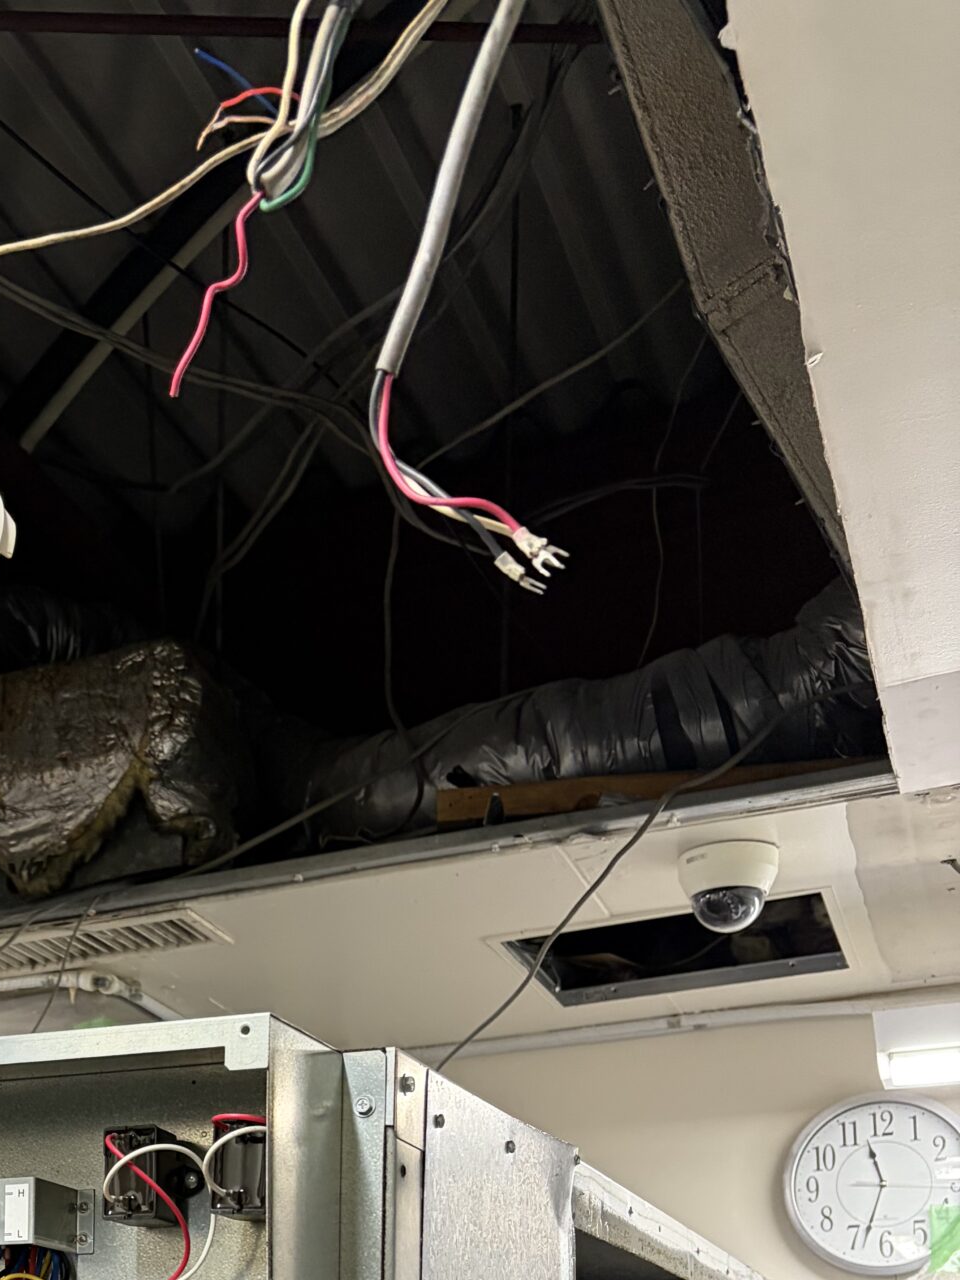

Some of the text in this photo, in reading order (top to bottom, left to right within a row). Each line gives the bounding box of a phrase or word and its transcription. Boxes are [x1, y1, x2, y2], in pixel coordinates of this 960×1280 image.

[839, 1120, 860, 1148] 11
[868, 1109, 894, 1137] 12
[908, 1114, 921, 1142] 1
[812, 1143, 836, 1172] 10
[932, 1135, 947, 1162] 2
[806, 1175, 820, 1203] 9
[820, 1205, 834, 1232] 8
[846, 1224, 860, 1251] 7
[879, 1230, 895, 1258] 6
[913, 1219, 928, 1248] 5
